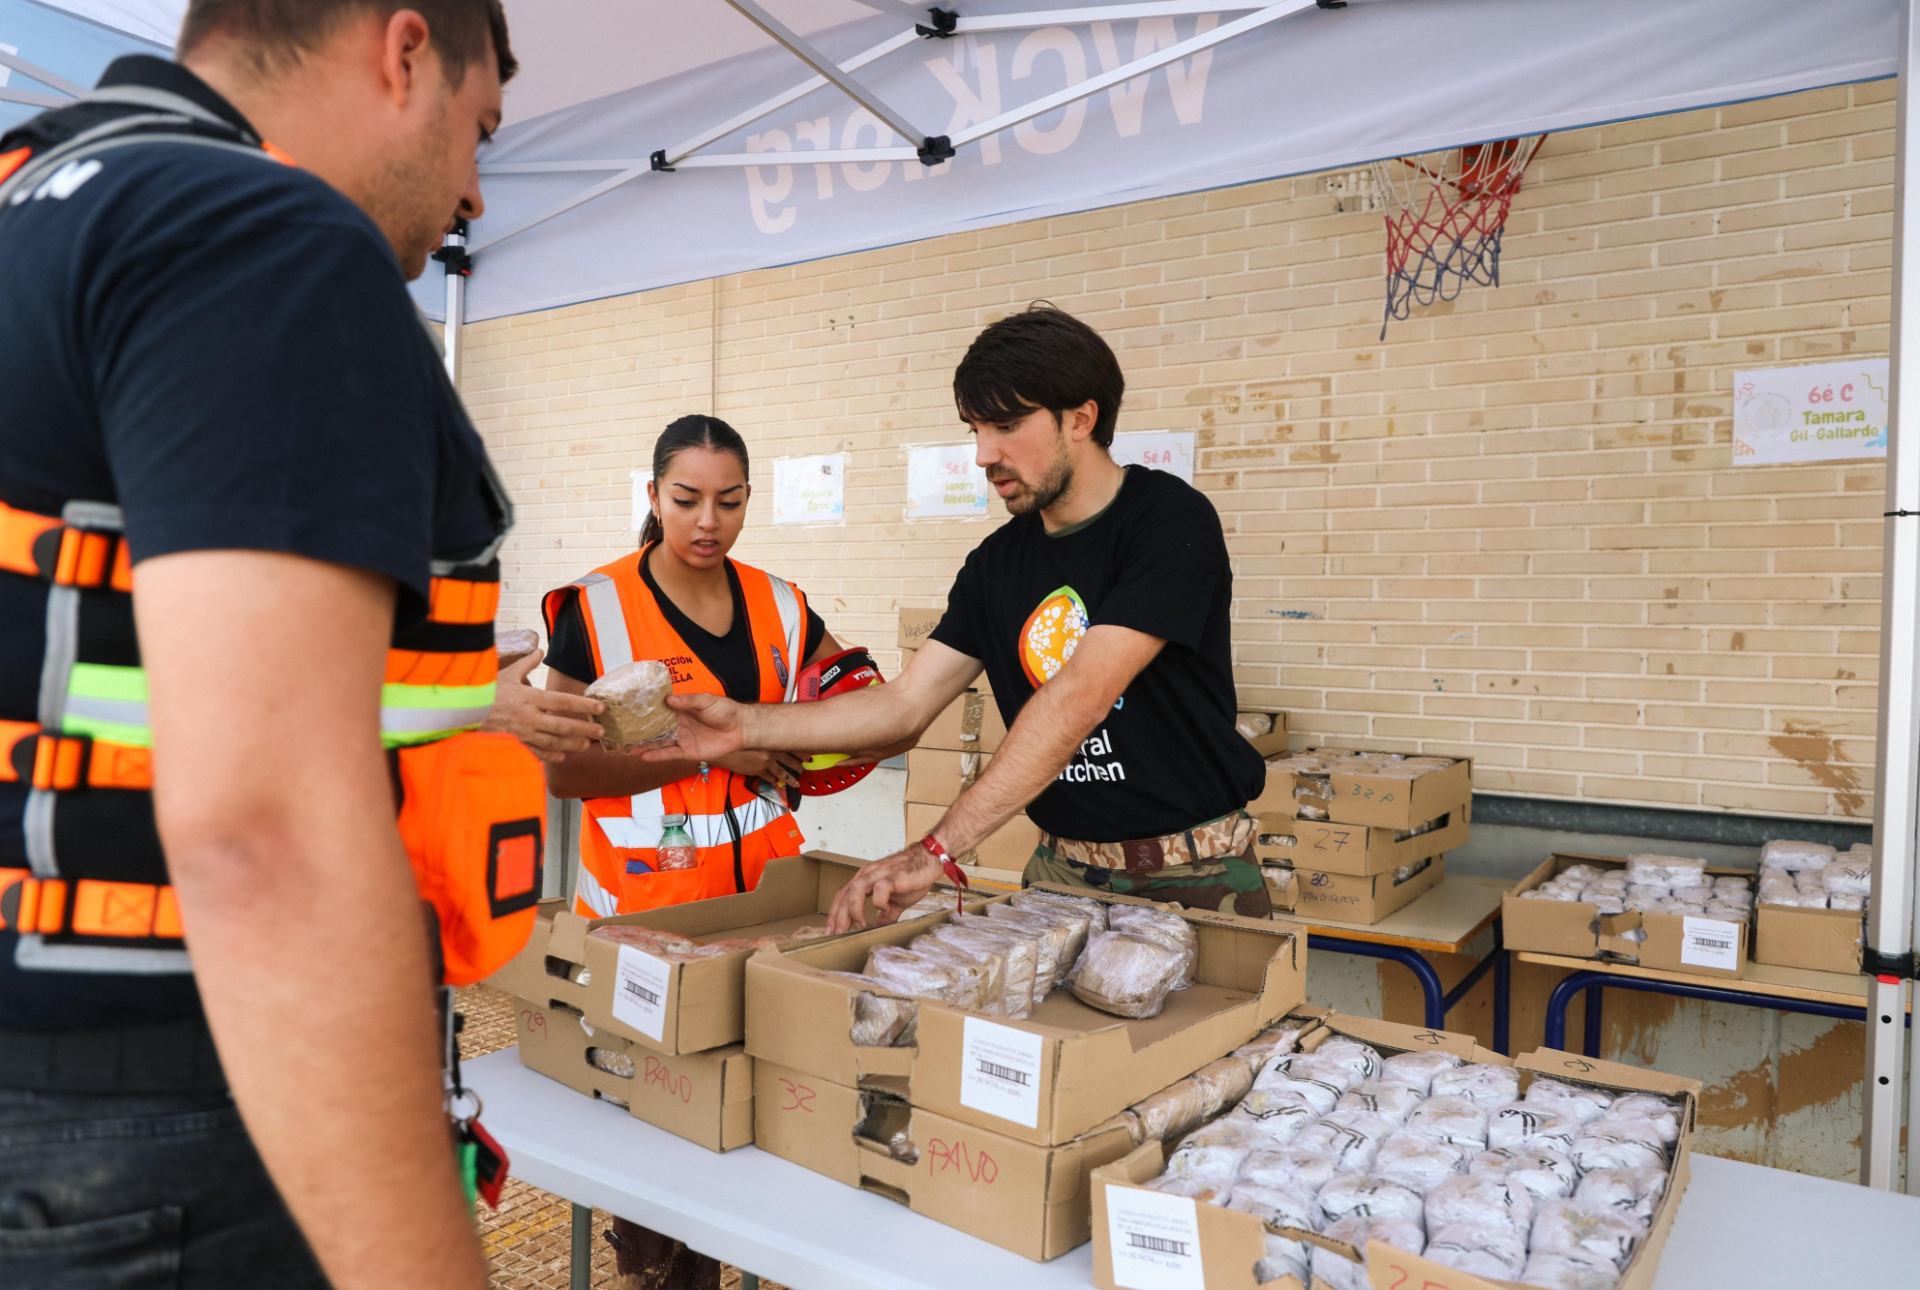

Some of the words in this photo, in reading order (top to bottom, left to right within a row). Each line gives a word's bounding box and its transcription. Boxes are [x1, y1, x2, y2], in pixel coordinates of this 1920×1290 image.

[1808, 384, 1834, 404] 6é
[1840, 383, 1854, 403] C
[1802, 409, 1865, 425] Tamara
[669, 667, 679, 675] IL
[1077, 729, 1113, 756] ral
[1313, 828, 1351, 853] 27
[644, 1055, 692, 1104] PAVO
[778, 1077, 816, 1113] 32
[927, 1137, 999, 1184] PAVO
[1389, 1264, 1451, 1290] 2
